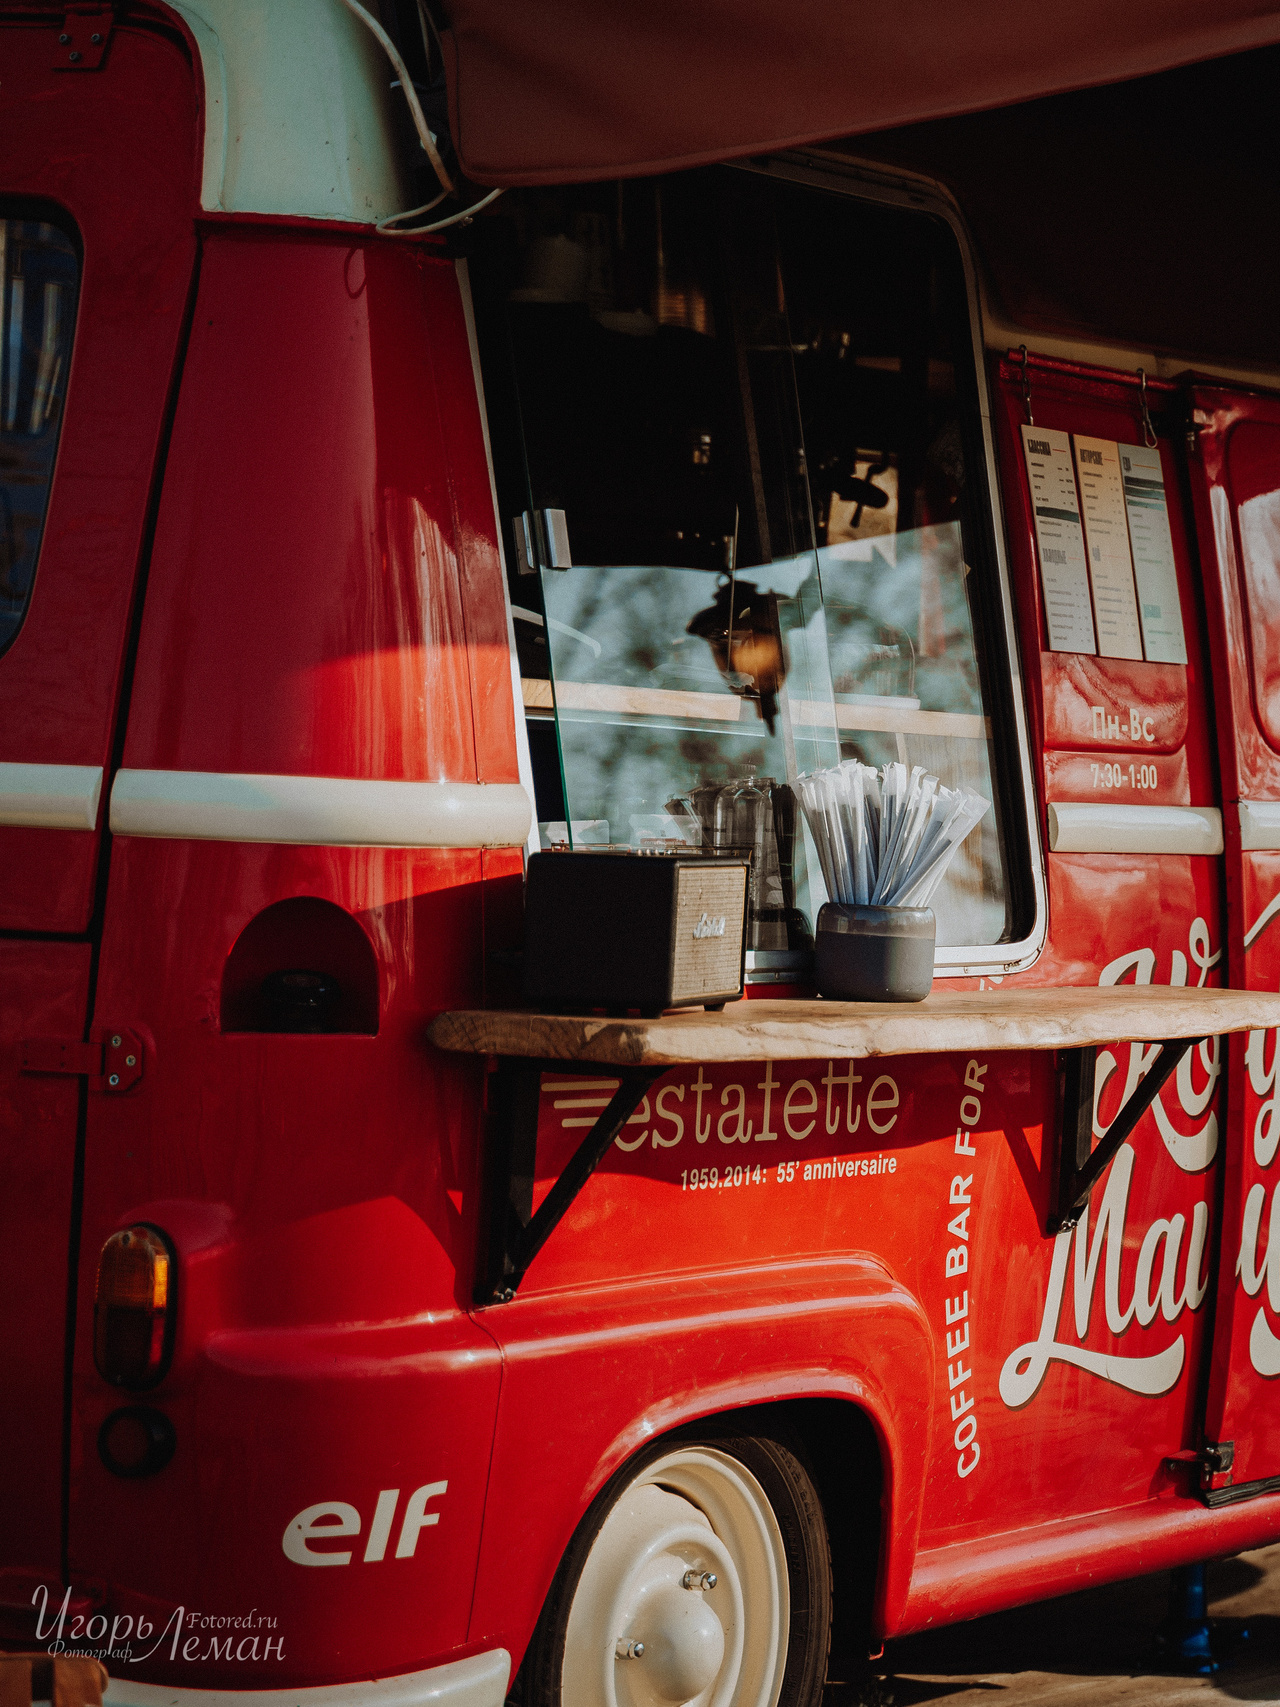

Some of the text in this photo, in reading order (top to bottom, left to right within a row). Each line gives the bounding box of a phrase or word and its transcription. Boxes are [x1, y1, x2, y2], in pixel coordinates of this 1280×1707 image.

[1092, 706, 1155, 742] Пн-Вс
[1090, 763, 1158, 790] 7:30-1:00
[803, 1154, 898, 1182] anniversaire
[945, 1059, 988, 1478] COFFEE BAR FOR
[282, 1480, 448, 1566] elf
